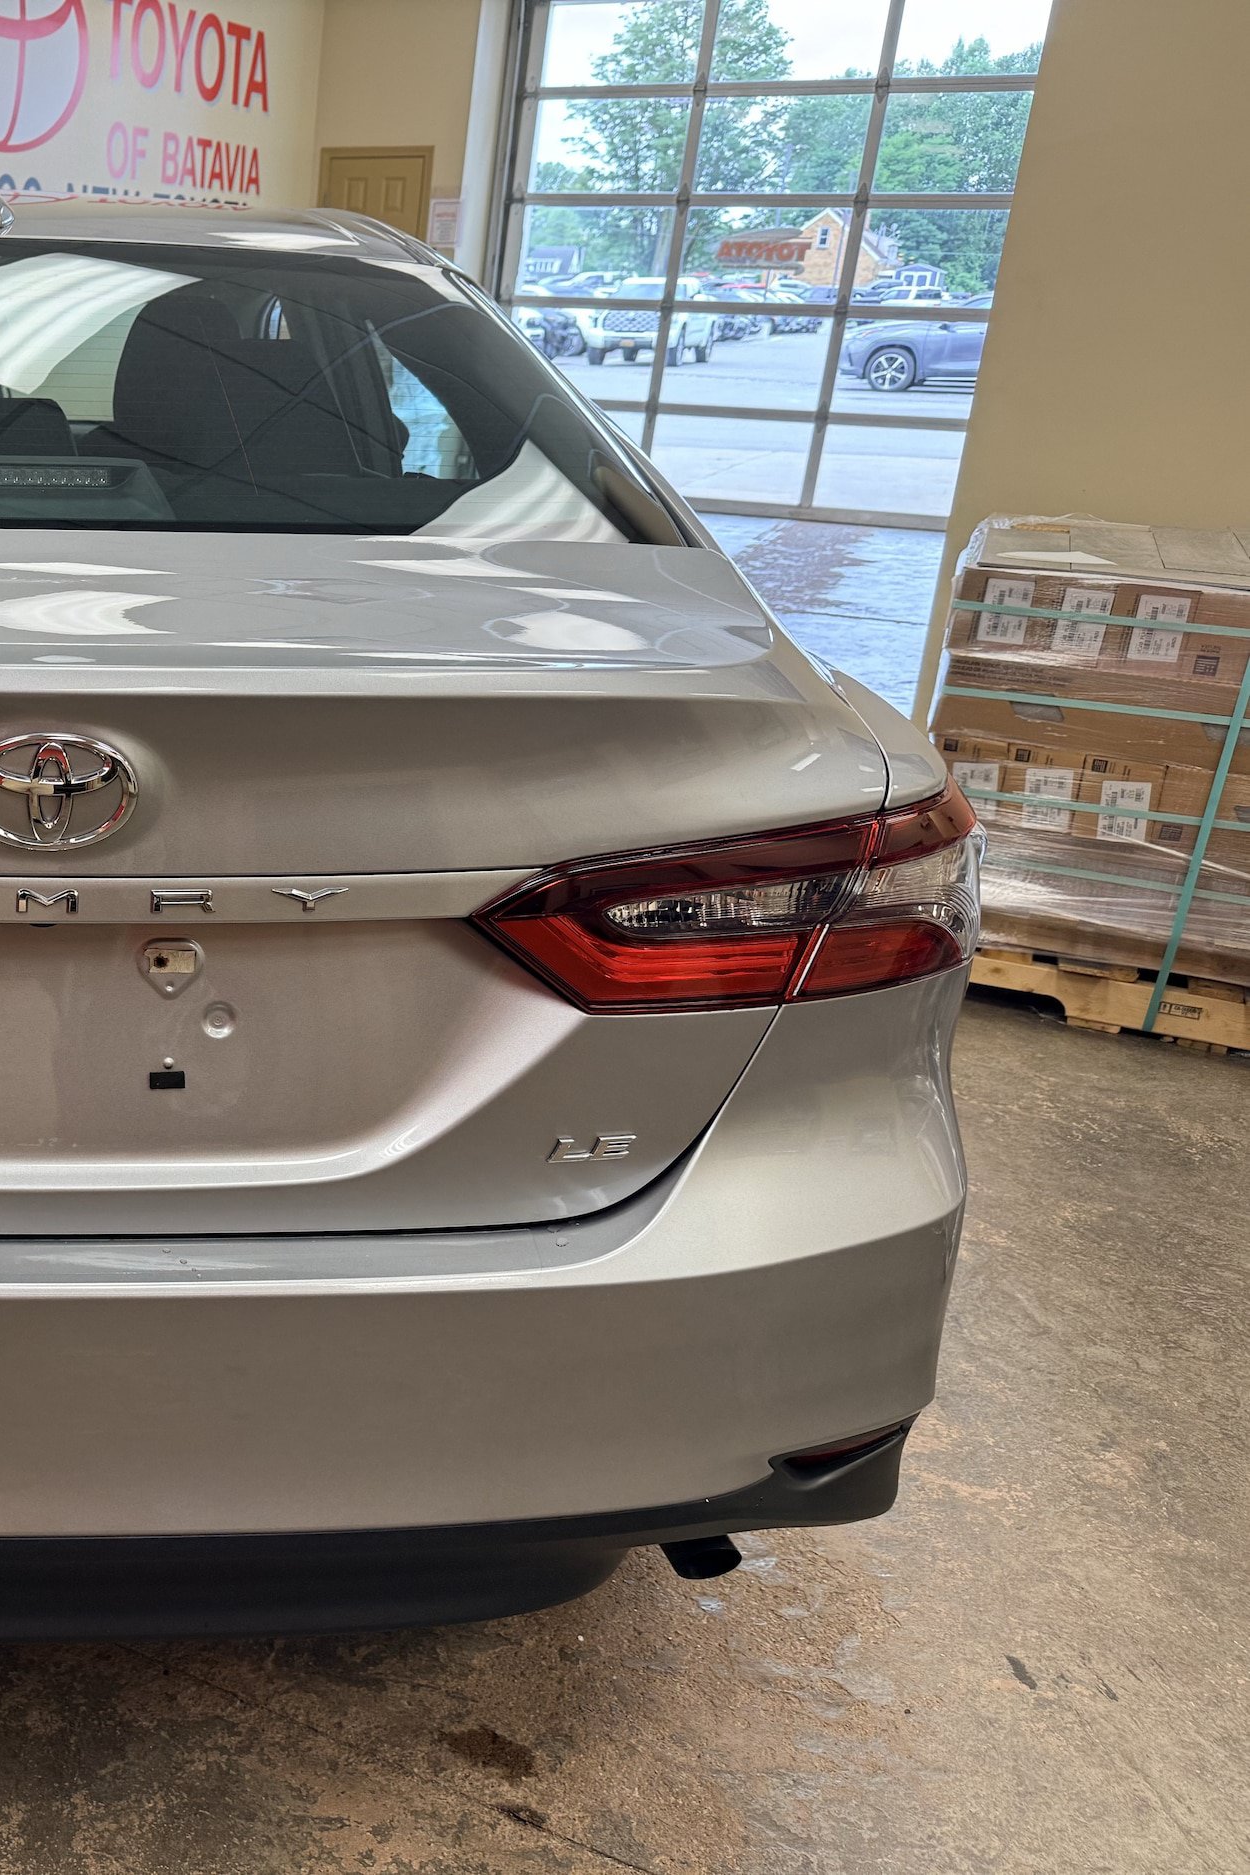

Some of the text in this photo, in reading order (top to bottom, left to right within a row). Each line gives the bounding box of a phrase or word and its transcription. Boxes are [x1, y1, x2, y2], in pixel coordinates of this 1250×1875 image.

[109, 0, 269, 113] TOYOTA
[106, 121, 149, 181] OF
[161, 132, 261, 196] BATAVIA
[546, 1132, 637, 1163] LE
